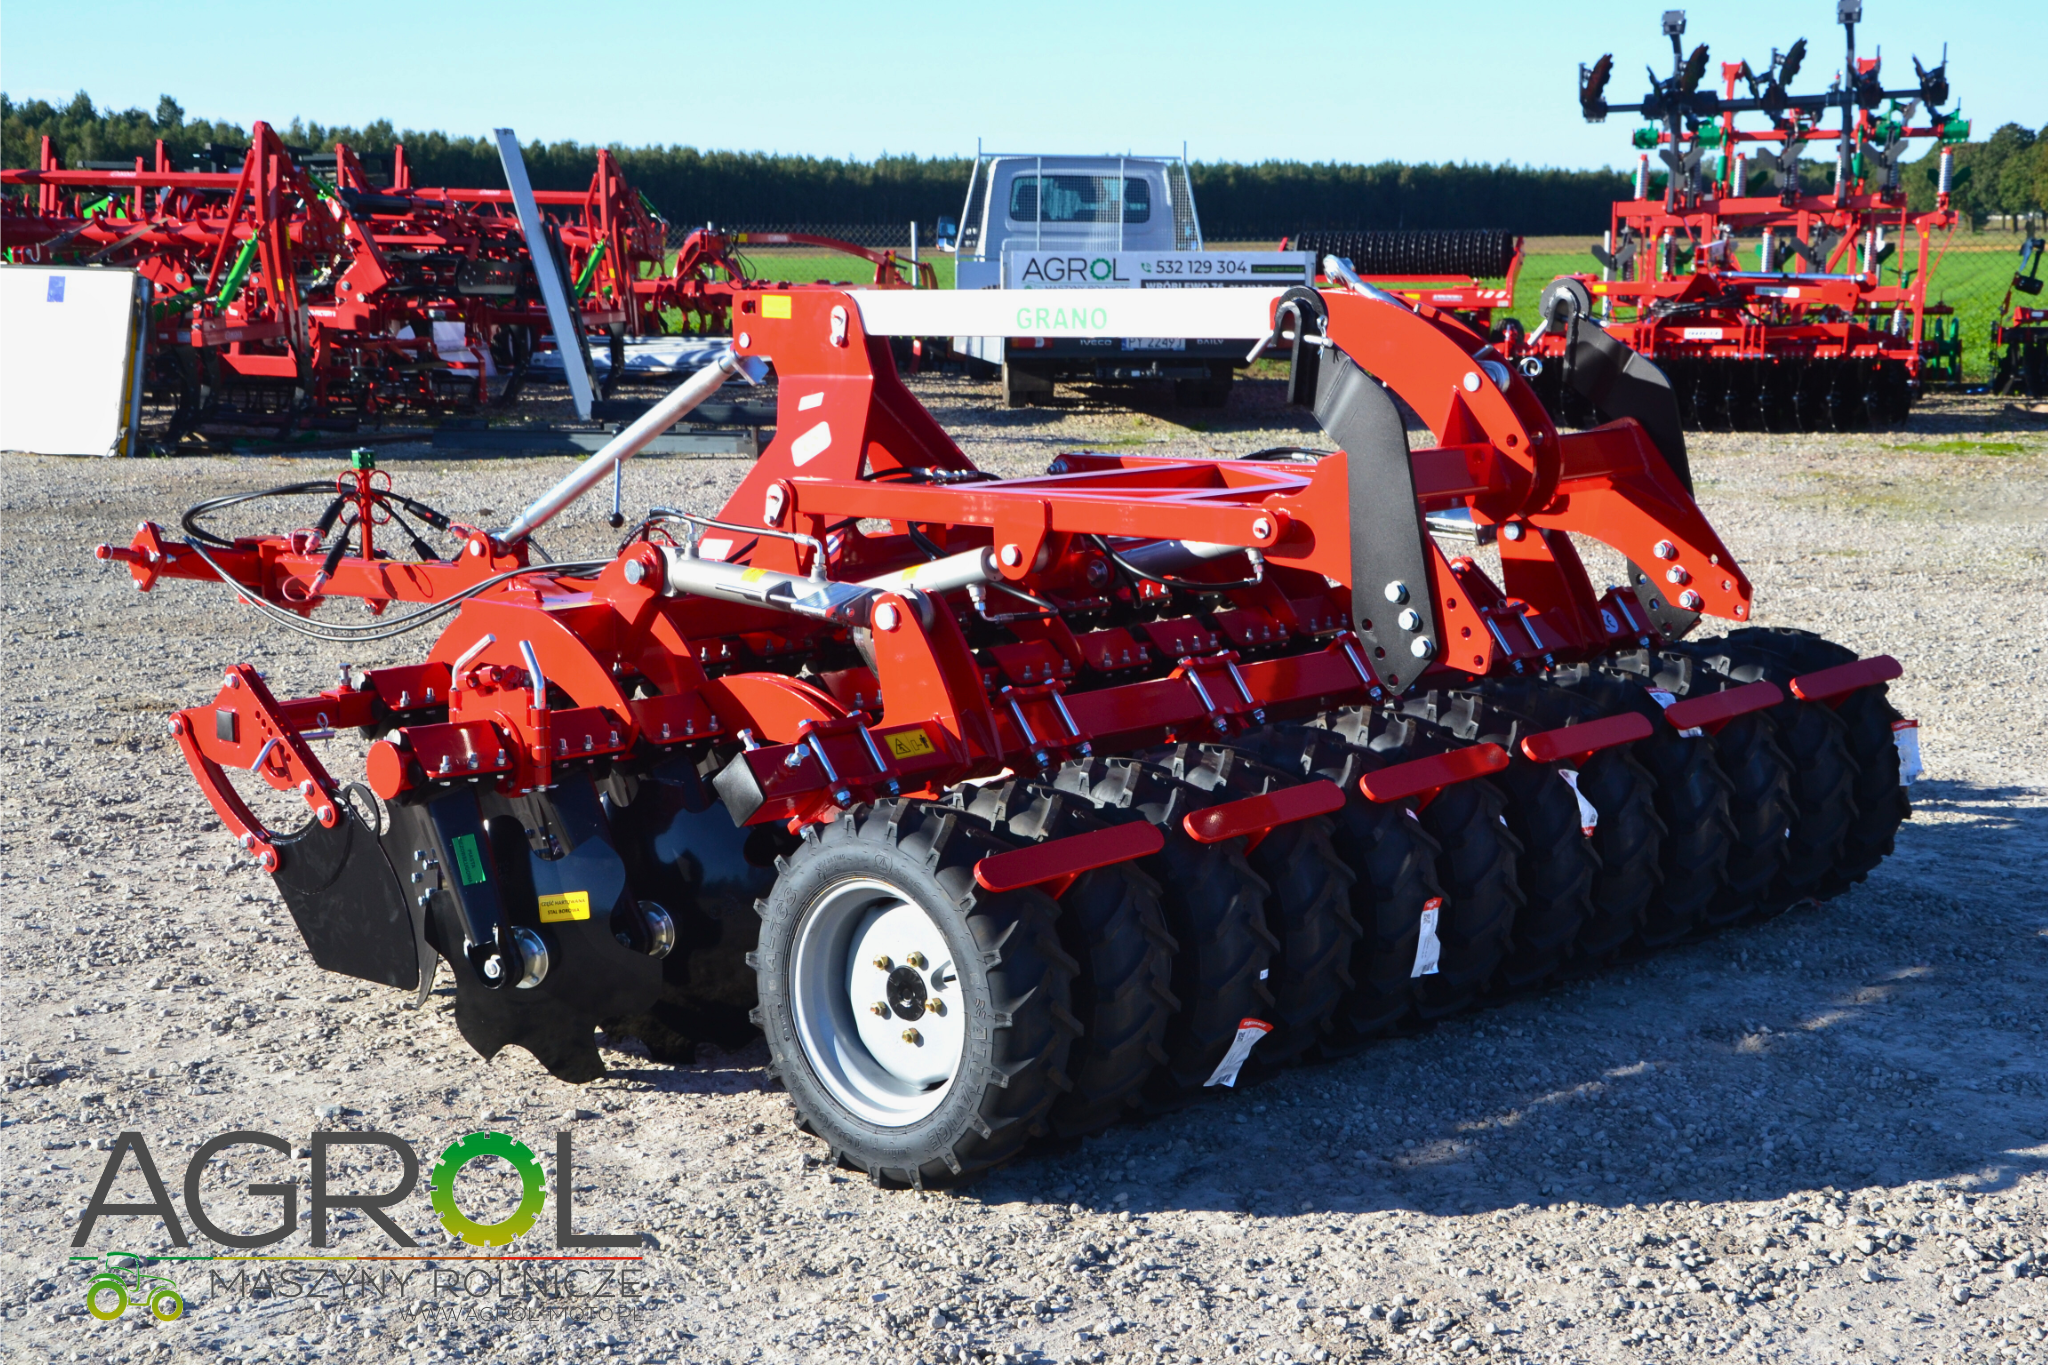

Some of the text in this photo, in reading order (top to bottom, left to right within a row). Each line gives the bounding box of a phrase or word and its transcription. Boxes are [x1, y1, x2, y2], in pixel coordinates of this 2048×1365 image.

[1021, 256, 1130, 281] AGROL
[1156, 259, 1247, 274] 532 129 304
[1016, 306, 1108, 330] GRANO
